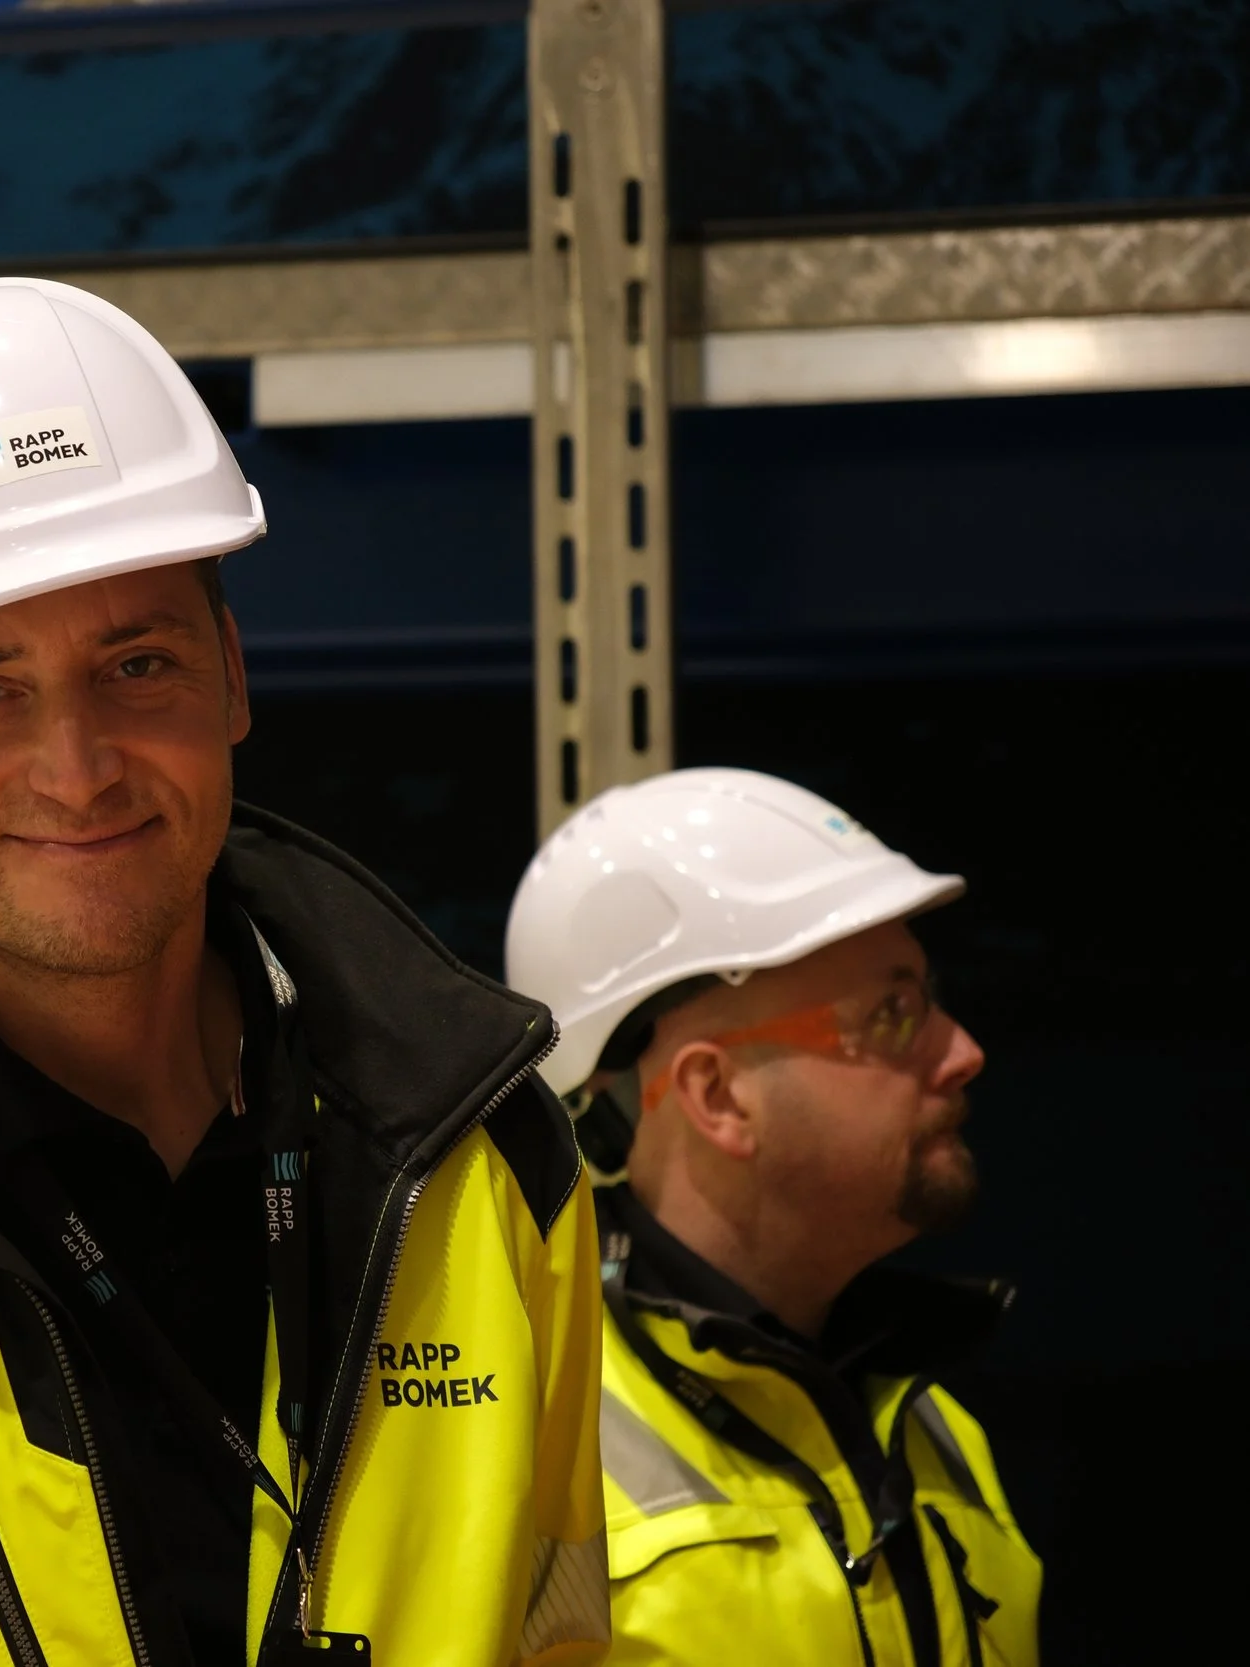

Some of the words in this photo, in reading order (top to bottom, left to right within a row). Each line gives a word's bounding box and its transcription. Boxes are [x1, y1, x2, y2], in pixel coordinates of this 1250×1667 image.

[9, 428, 65, 452] RAPP
[14, 442, 88, 468] BOMEK
[265, 1187, 281, 1242] BOMEK
[280, 1187, 294, 1230] RAPP
[61, 1234, 93, 1272] RAPP
[65, 1211, 104, 1263] BOMEK
[376, 1342, 461, 1371] RAPP
[381, 1373, 500, 1408] BOMEK
[220, 1415, 259, 1465] BOMEK
[222, 1433, 253, 1469] RAPP
